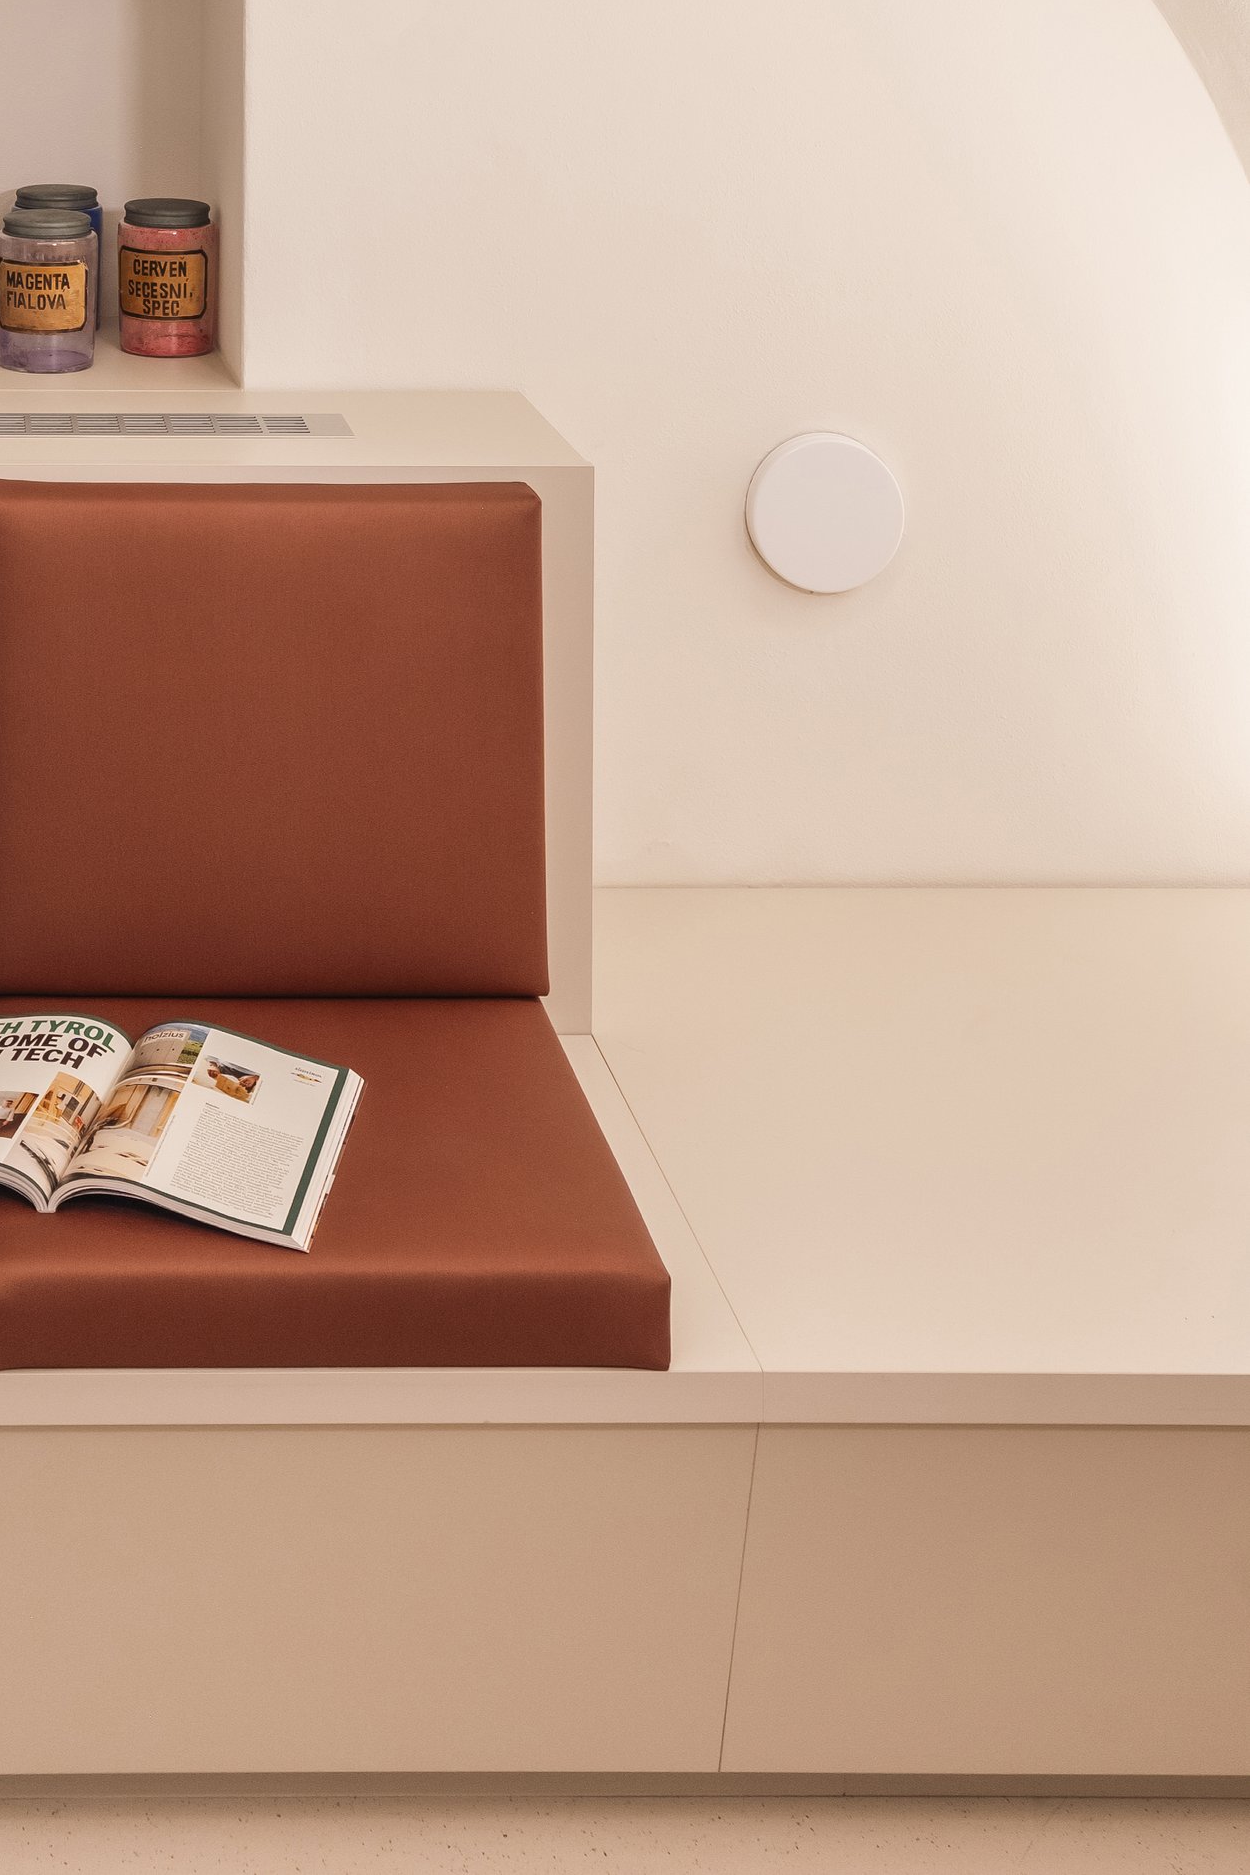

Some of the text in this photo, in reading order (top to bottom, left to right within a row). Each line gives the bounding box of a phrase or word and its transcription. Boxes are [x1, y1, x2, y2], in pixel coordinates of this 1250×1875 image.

[133, 254, 187, 278] ČERVEŇ
[6, 270, 71, 291] MAGENTA
[30, 1020, 116, 1054] TYROL
[67, 1037, 108, 1059] OF
[10, 1048, 84, 1070] TECH
